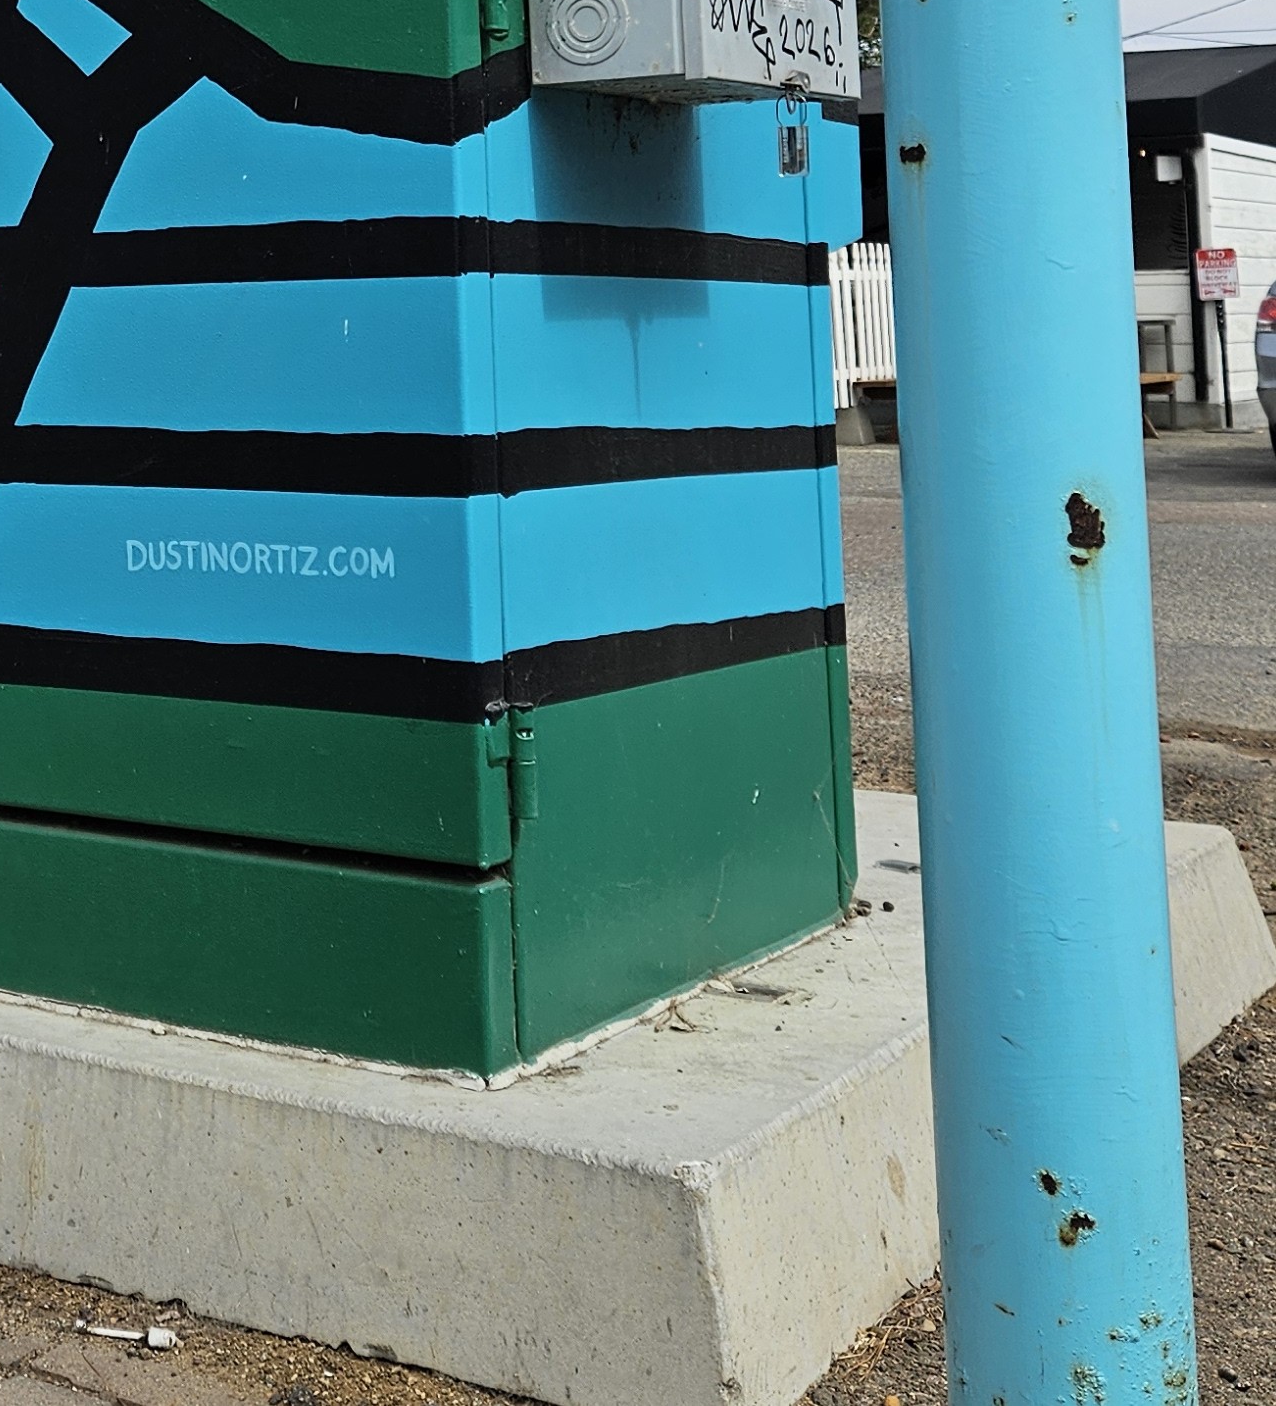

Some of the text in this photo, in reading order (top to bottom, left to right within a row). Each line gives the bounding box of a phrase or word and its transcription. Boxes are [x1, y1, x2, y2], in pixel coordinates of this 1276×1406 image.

[1208, 250, 1225, 260] NO
[1198, 259, 1236, 269] PARKING
[126, 539, 395, 579] DUSTINORTIZ.COM
